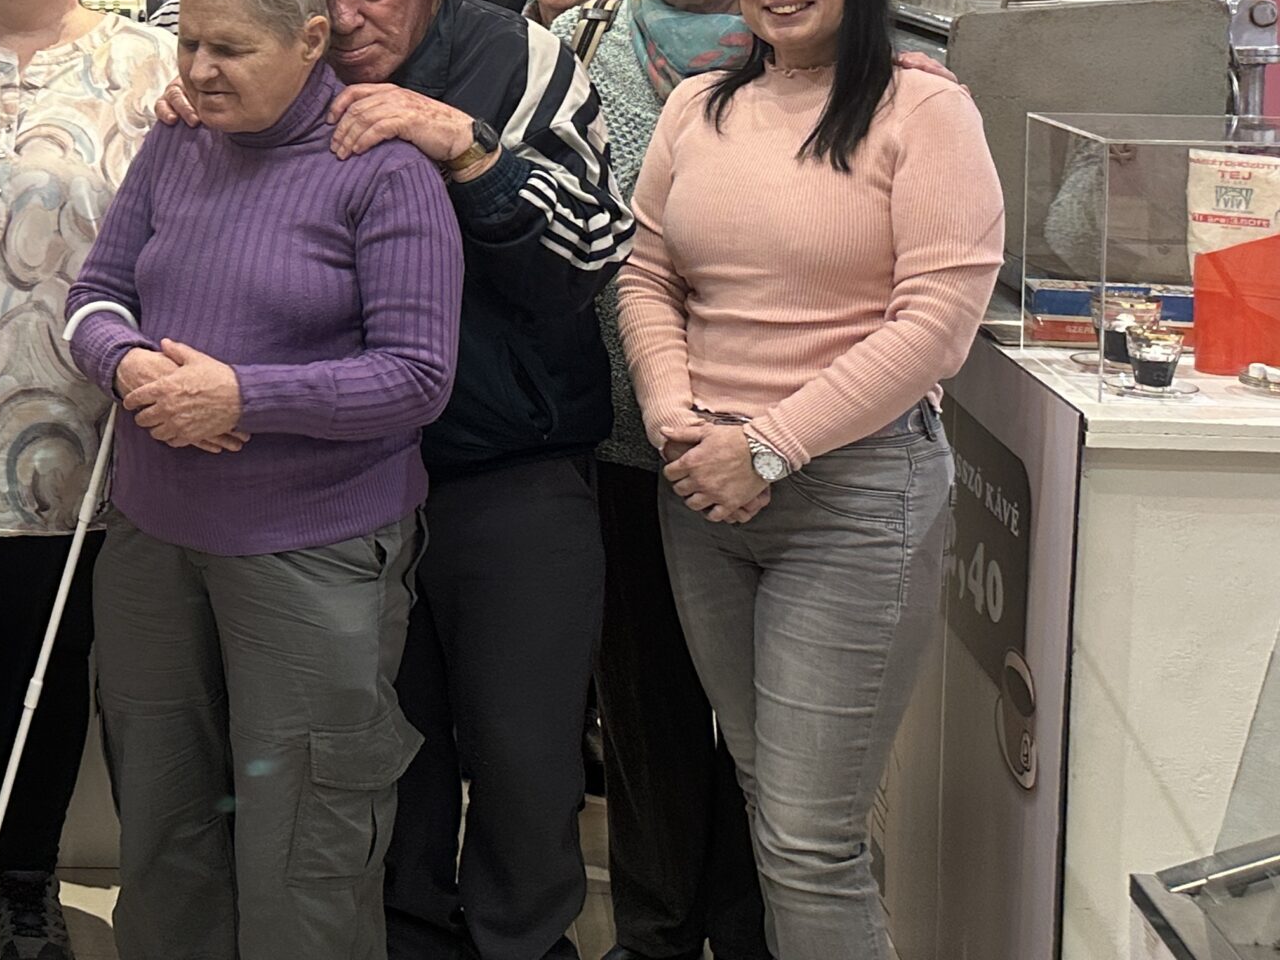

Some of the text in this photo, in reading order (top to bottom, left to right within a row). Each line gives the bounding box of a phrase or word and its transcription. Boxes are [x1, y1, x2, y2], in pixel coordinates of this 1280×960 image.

[1218, 170, 1252, 180] TEJ
[953, 449, 1020, 537] SSZÓ KÁVÉ
